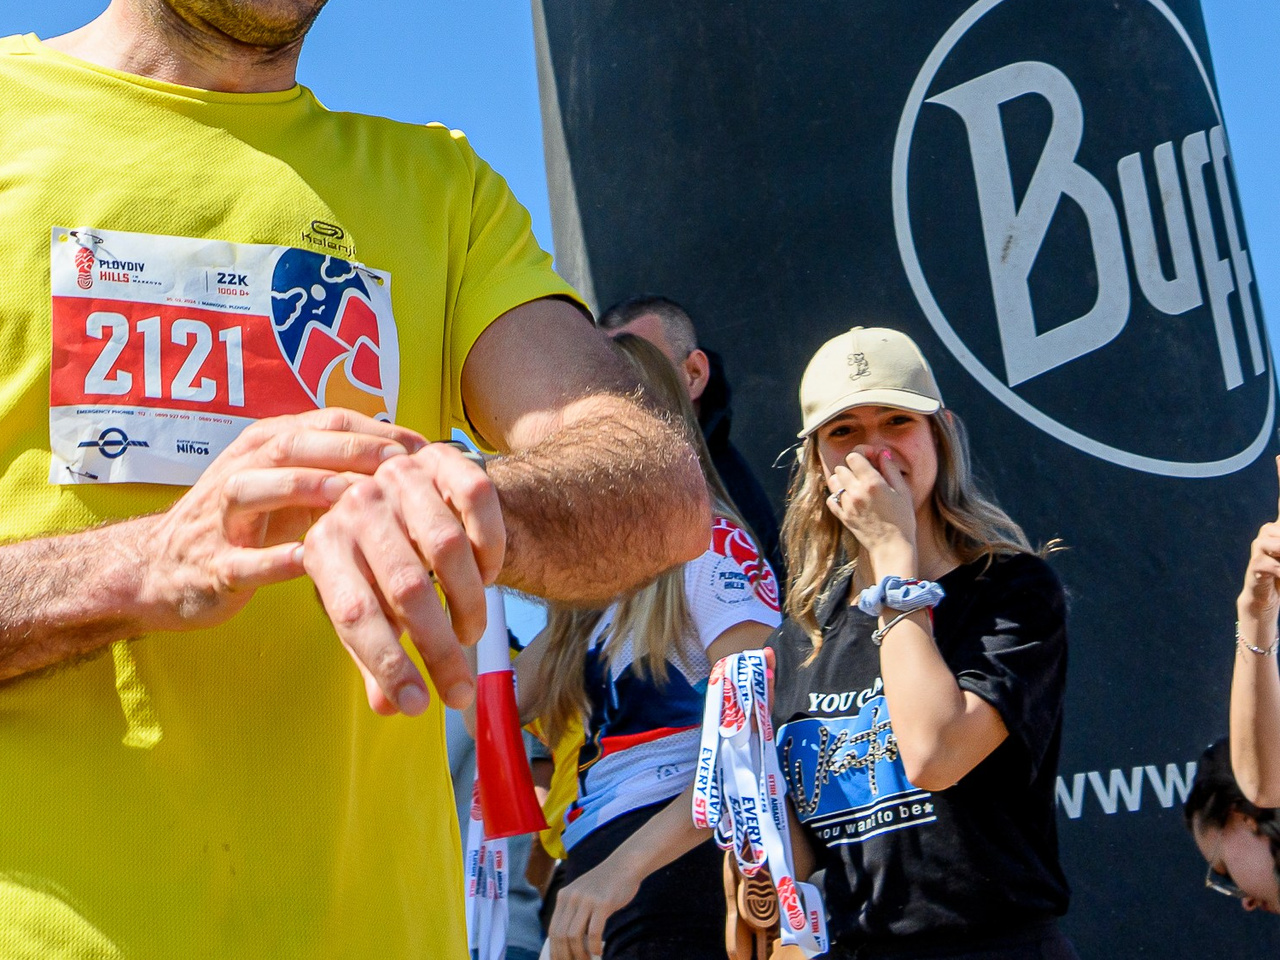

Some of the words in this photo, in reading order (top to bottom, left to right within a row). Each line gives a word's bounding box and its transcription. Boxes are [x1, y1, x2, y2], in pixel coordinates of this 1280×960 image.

[924, 60, 1266, 391] Buff
[99, 259, 145, 273] PLOVDIV
[99, 271, 130, 283] HILLS
[216, 272, 249, 287] 22K
[217, 287, 238, 296] 1000
[83, 310, 246, 408] 2121
[748, 655, 766, 701] EVERY
[808, 691, 857, 712] YOU
[696, 747, 713, 796] EVERY
[741, 796, 763, 847] EVERY
[877, 810, 894, 824] to
[899, 804, 922, 819] be
